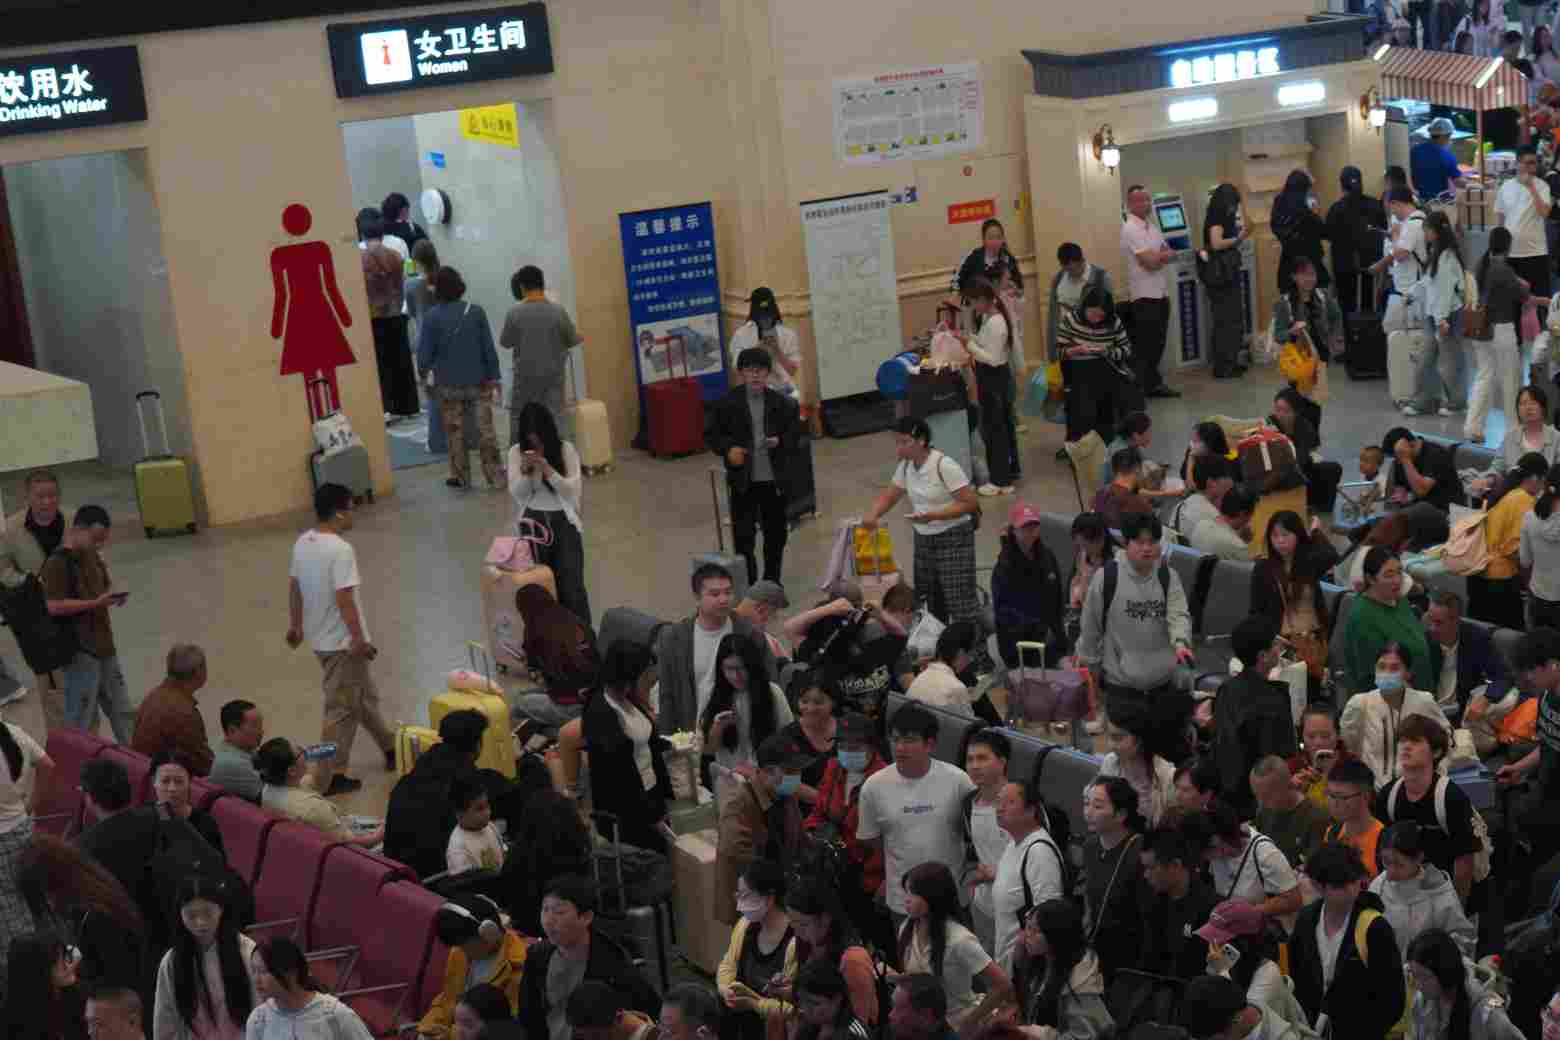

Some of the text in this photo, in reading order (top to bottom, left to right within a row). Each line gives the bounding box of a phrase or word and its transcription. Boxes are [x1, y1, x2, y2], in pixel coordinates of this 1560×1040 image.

[414, 20, 527, 59] 女卫生间
[417, 60, 468, 76] Women
[0, 64, 94, 104] 饮用水
[0, 98, 107, 121] Drinking Water
